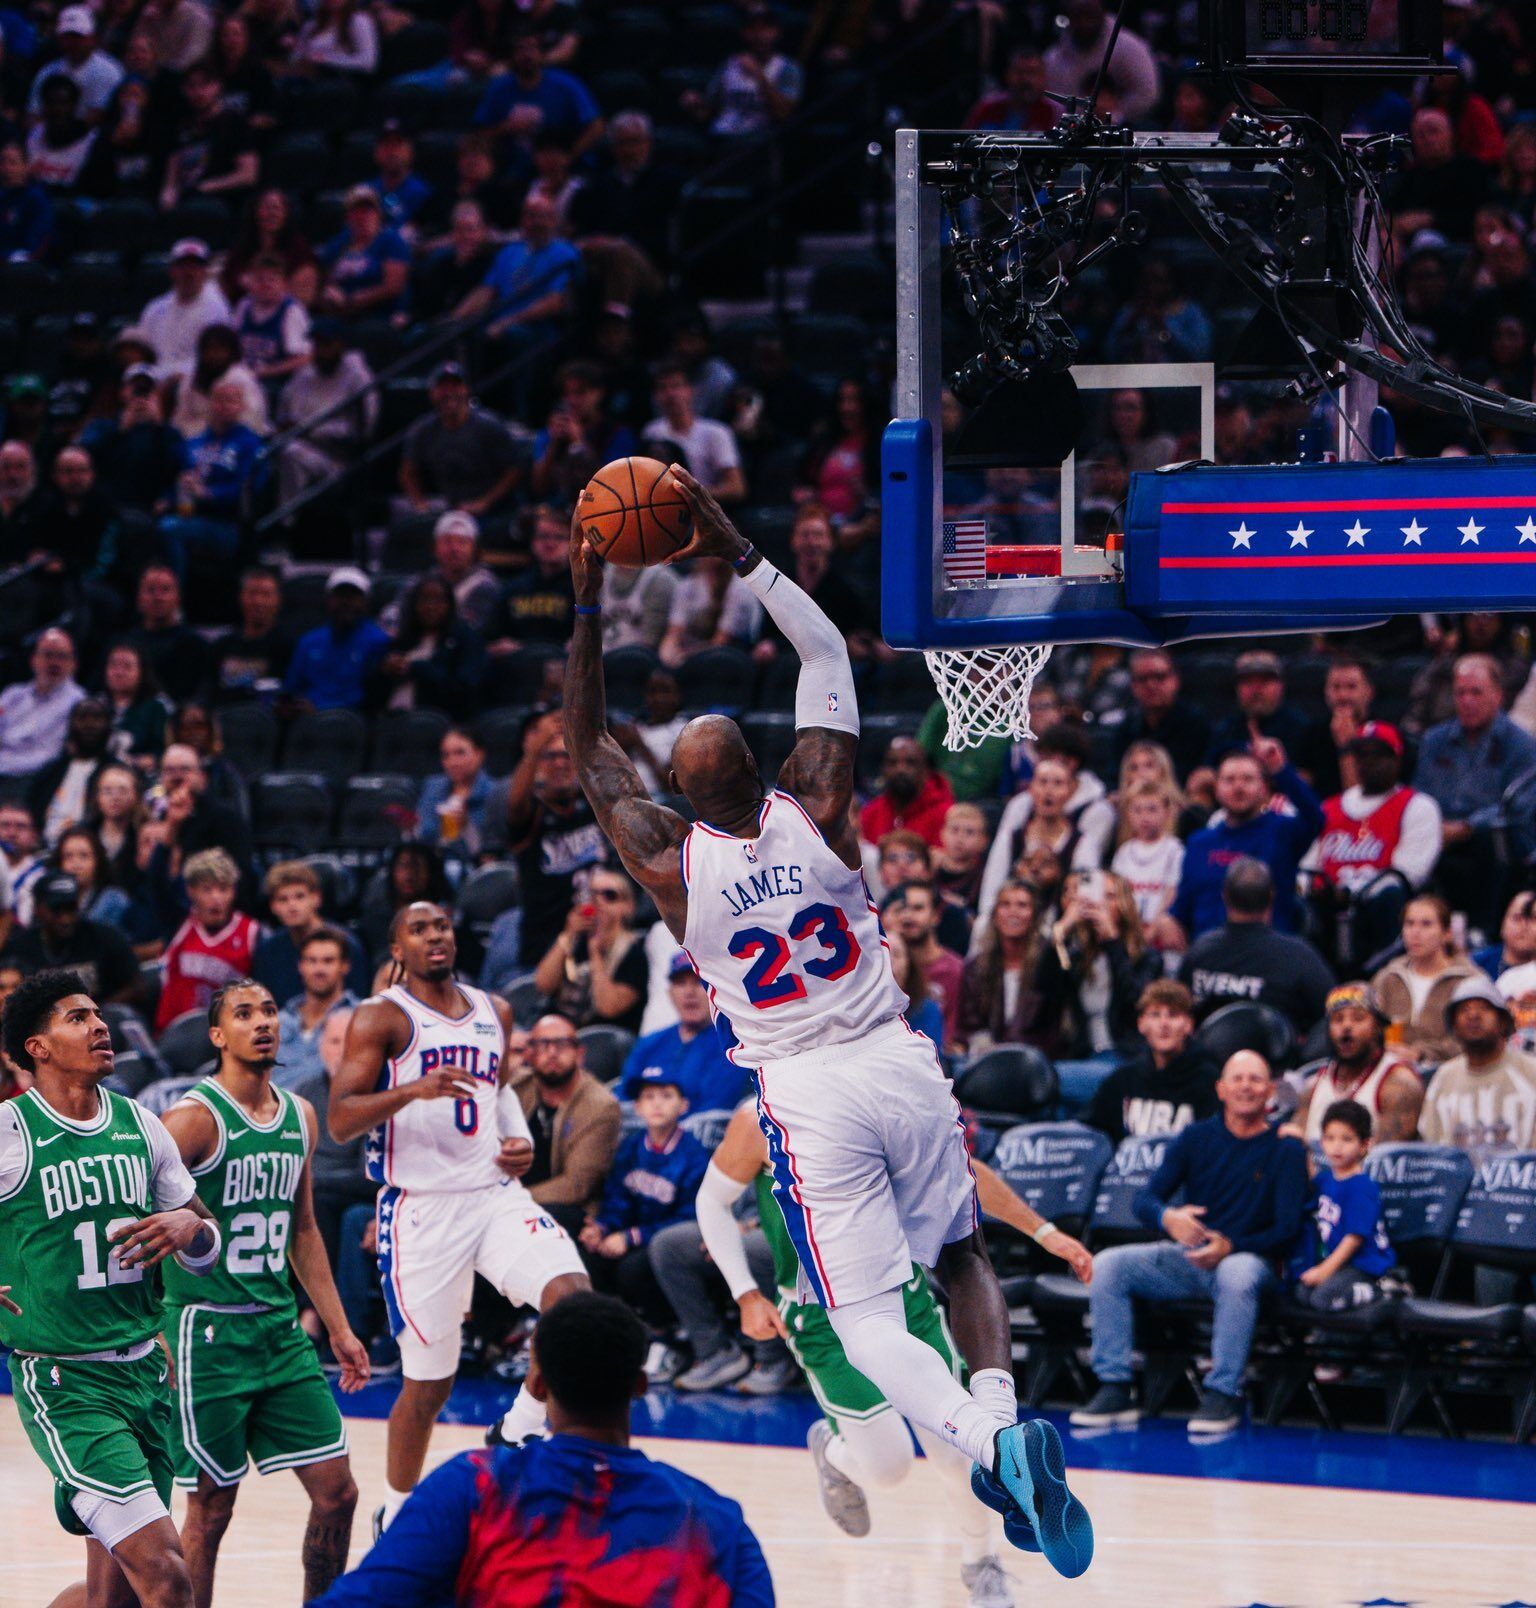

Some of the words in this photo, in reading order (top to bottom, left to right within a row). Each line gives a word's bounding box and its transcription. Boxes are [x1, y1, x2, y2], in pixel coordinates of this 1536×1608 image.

[721, 865, 803, 917] JAMES
[727, 902, 862, 1010] 23
[112, 1131, 142, 1141] Amica
[455, 1097, 479, 1136] 0
[39, 1153, 148, 1220] BOSTON
[226, 1210, 290, 1274] 29
